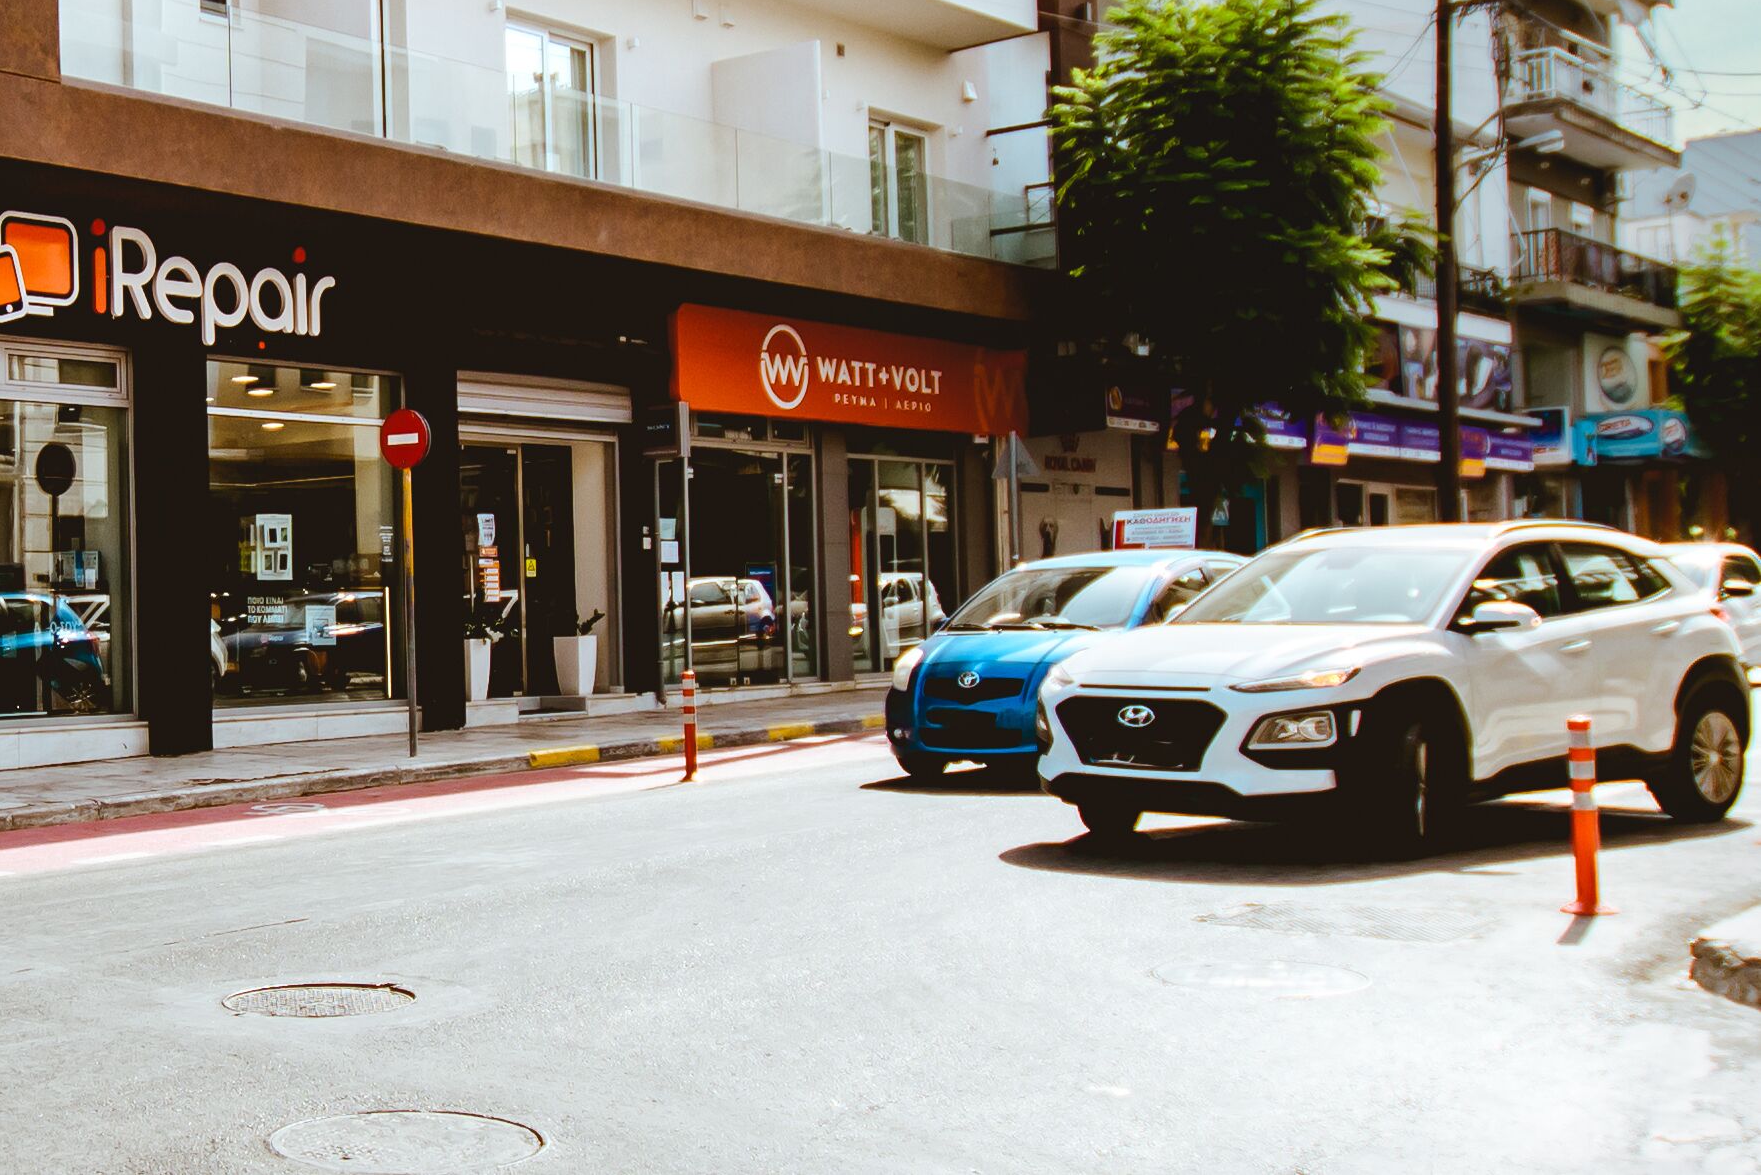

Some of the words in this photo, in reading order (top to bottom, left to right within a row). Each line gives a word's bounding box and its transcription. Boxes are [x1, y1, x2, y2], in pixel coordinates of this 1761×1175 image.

[91, 218, 336, 346] iRepair
[817, 356, 943, 395] WATT+VOLT
[834, 393, 877, 407] ΡΕΥΜΑ
[895, 398, 932, 413] ΑΕΡΙΟ
